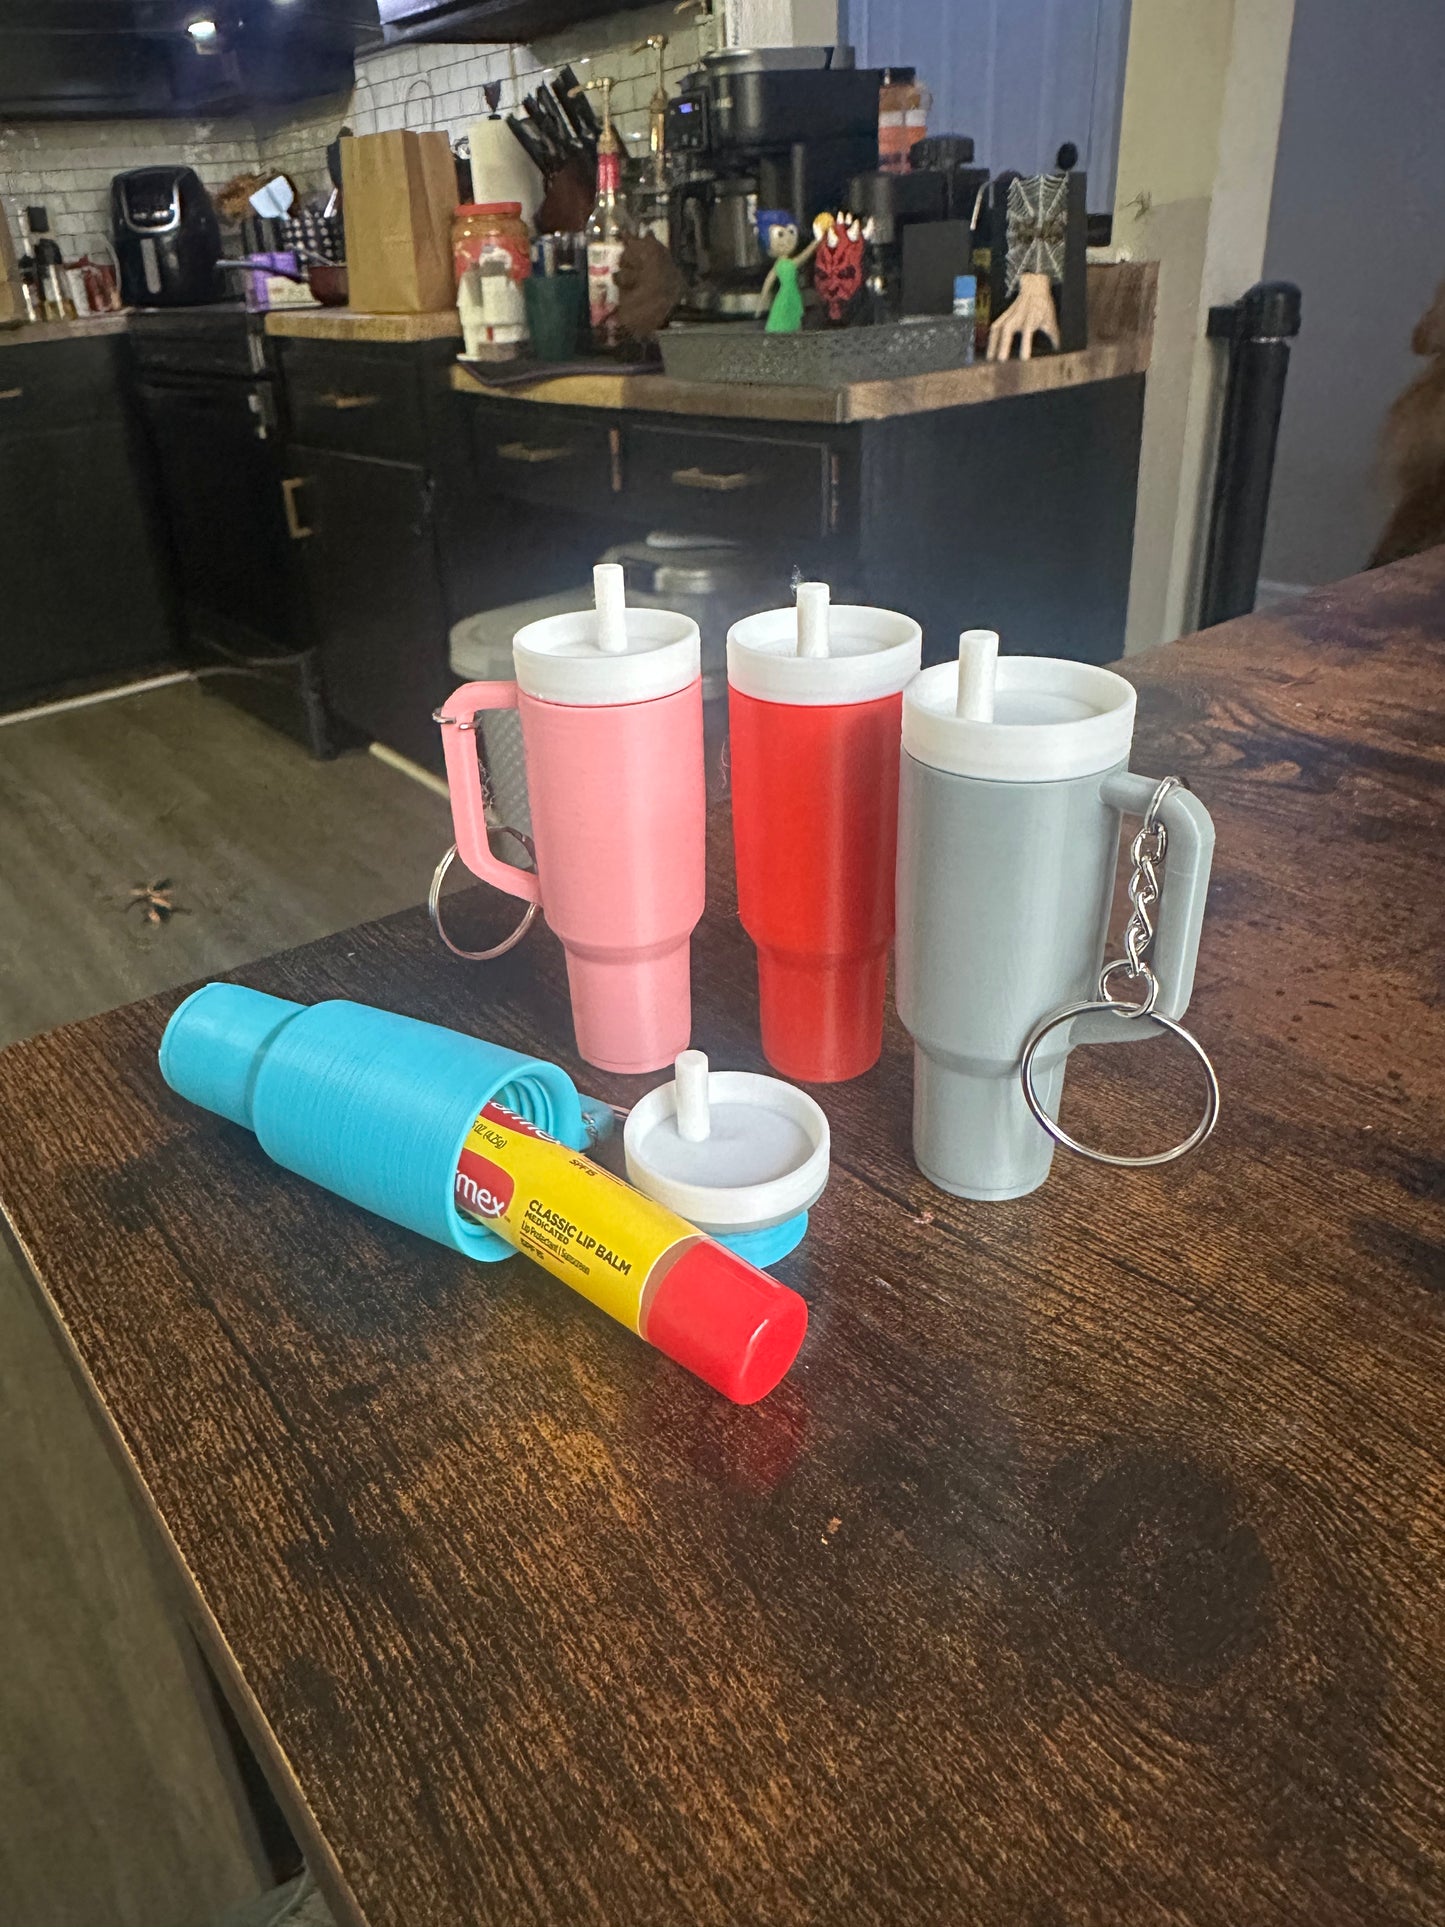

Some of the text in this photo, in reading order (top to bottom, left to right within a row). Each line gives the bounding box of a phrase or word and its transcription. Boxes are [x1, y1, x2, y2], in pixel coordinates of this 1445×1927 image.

[455, 1170, 505, 1218] mex
[524, 1209, 570, 1246] MEDICATED
[529, 1199, 632, 1276] CLASSIC LIP BALM
